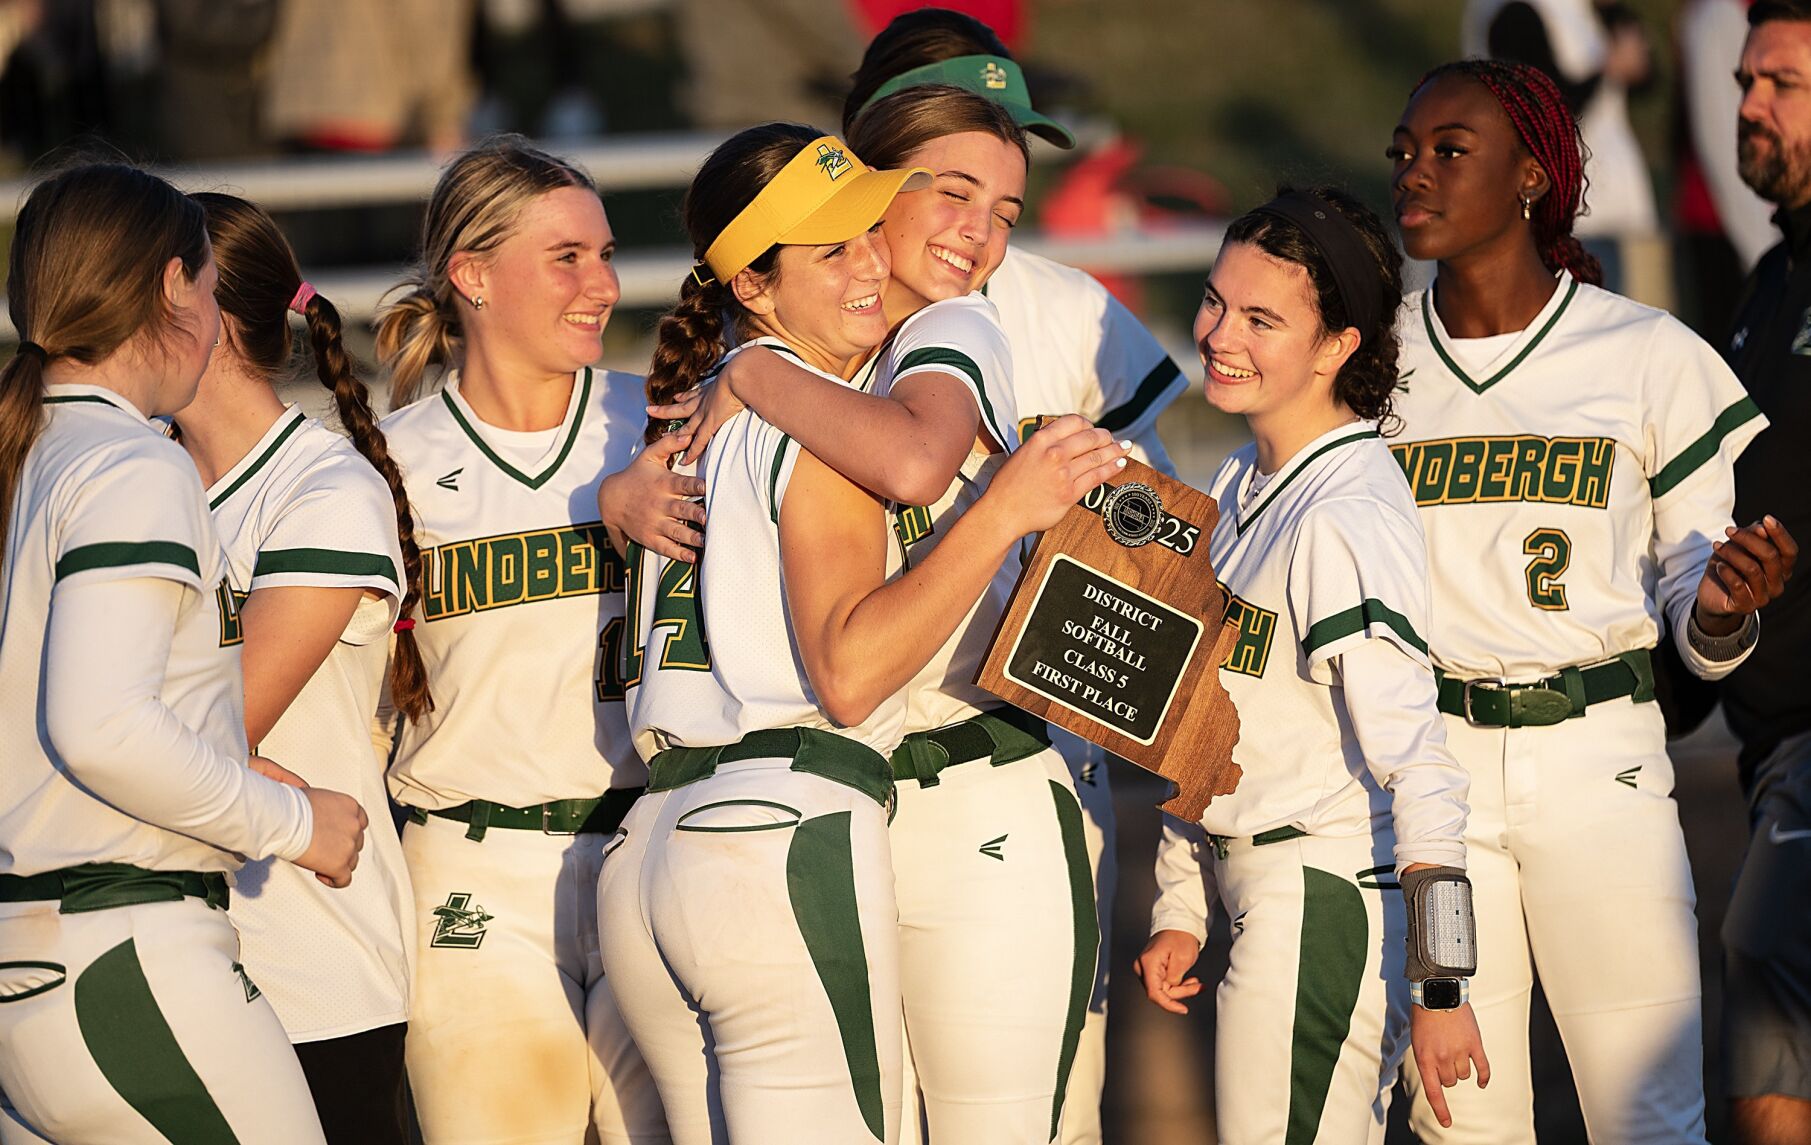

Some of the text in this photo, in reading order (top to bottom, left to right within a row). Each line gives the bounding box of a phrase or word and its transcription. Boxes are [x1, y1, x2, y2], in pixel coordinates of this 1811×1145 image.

[1158, 518, 1200, 553] 25
[1523, 528, 1571, 611] 2
[1082, 583, 1163, 632] DISTRICT
[1090, 614, 1132, 647] FALL
[1061, 620, 1147, 672] SOFTBALL
[1063, 649, 1129, 689] CLASS 5
[1031, 660, 1138, 722] FIRST PLACE
